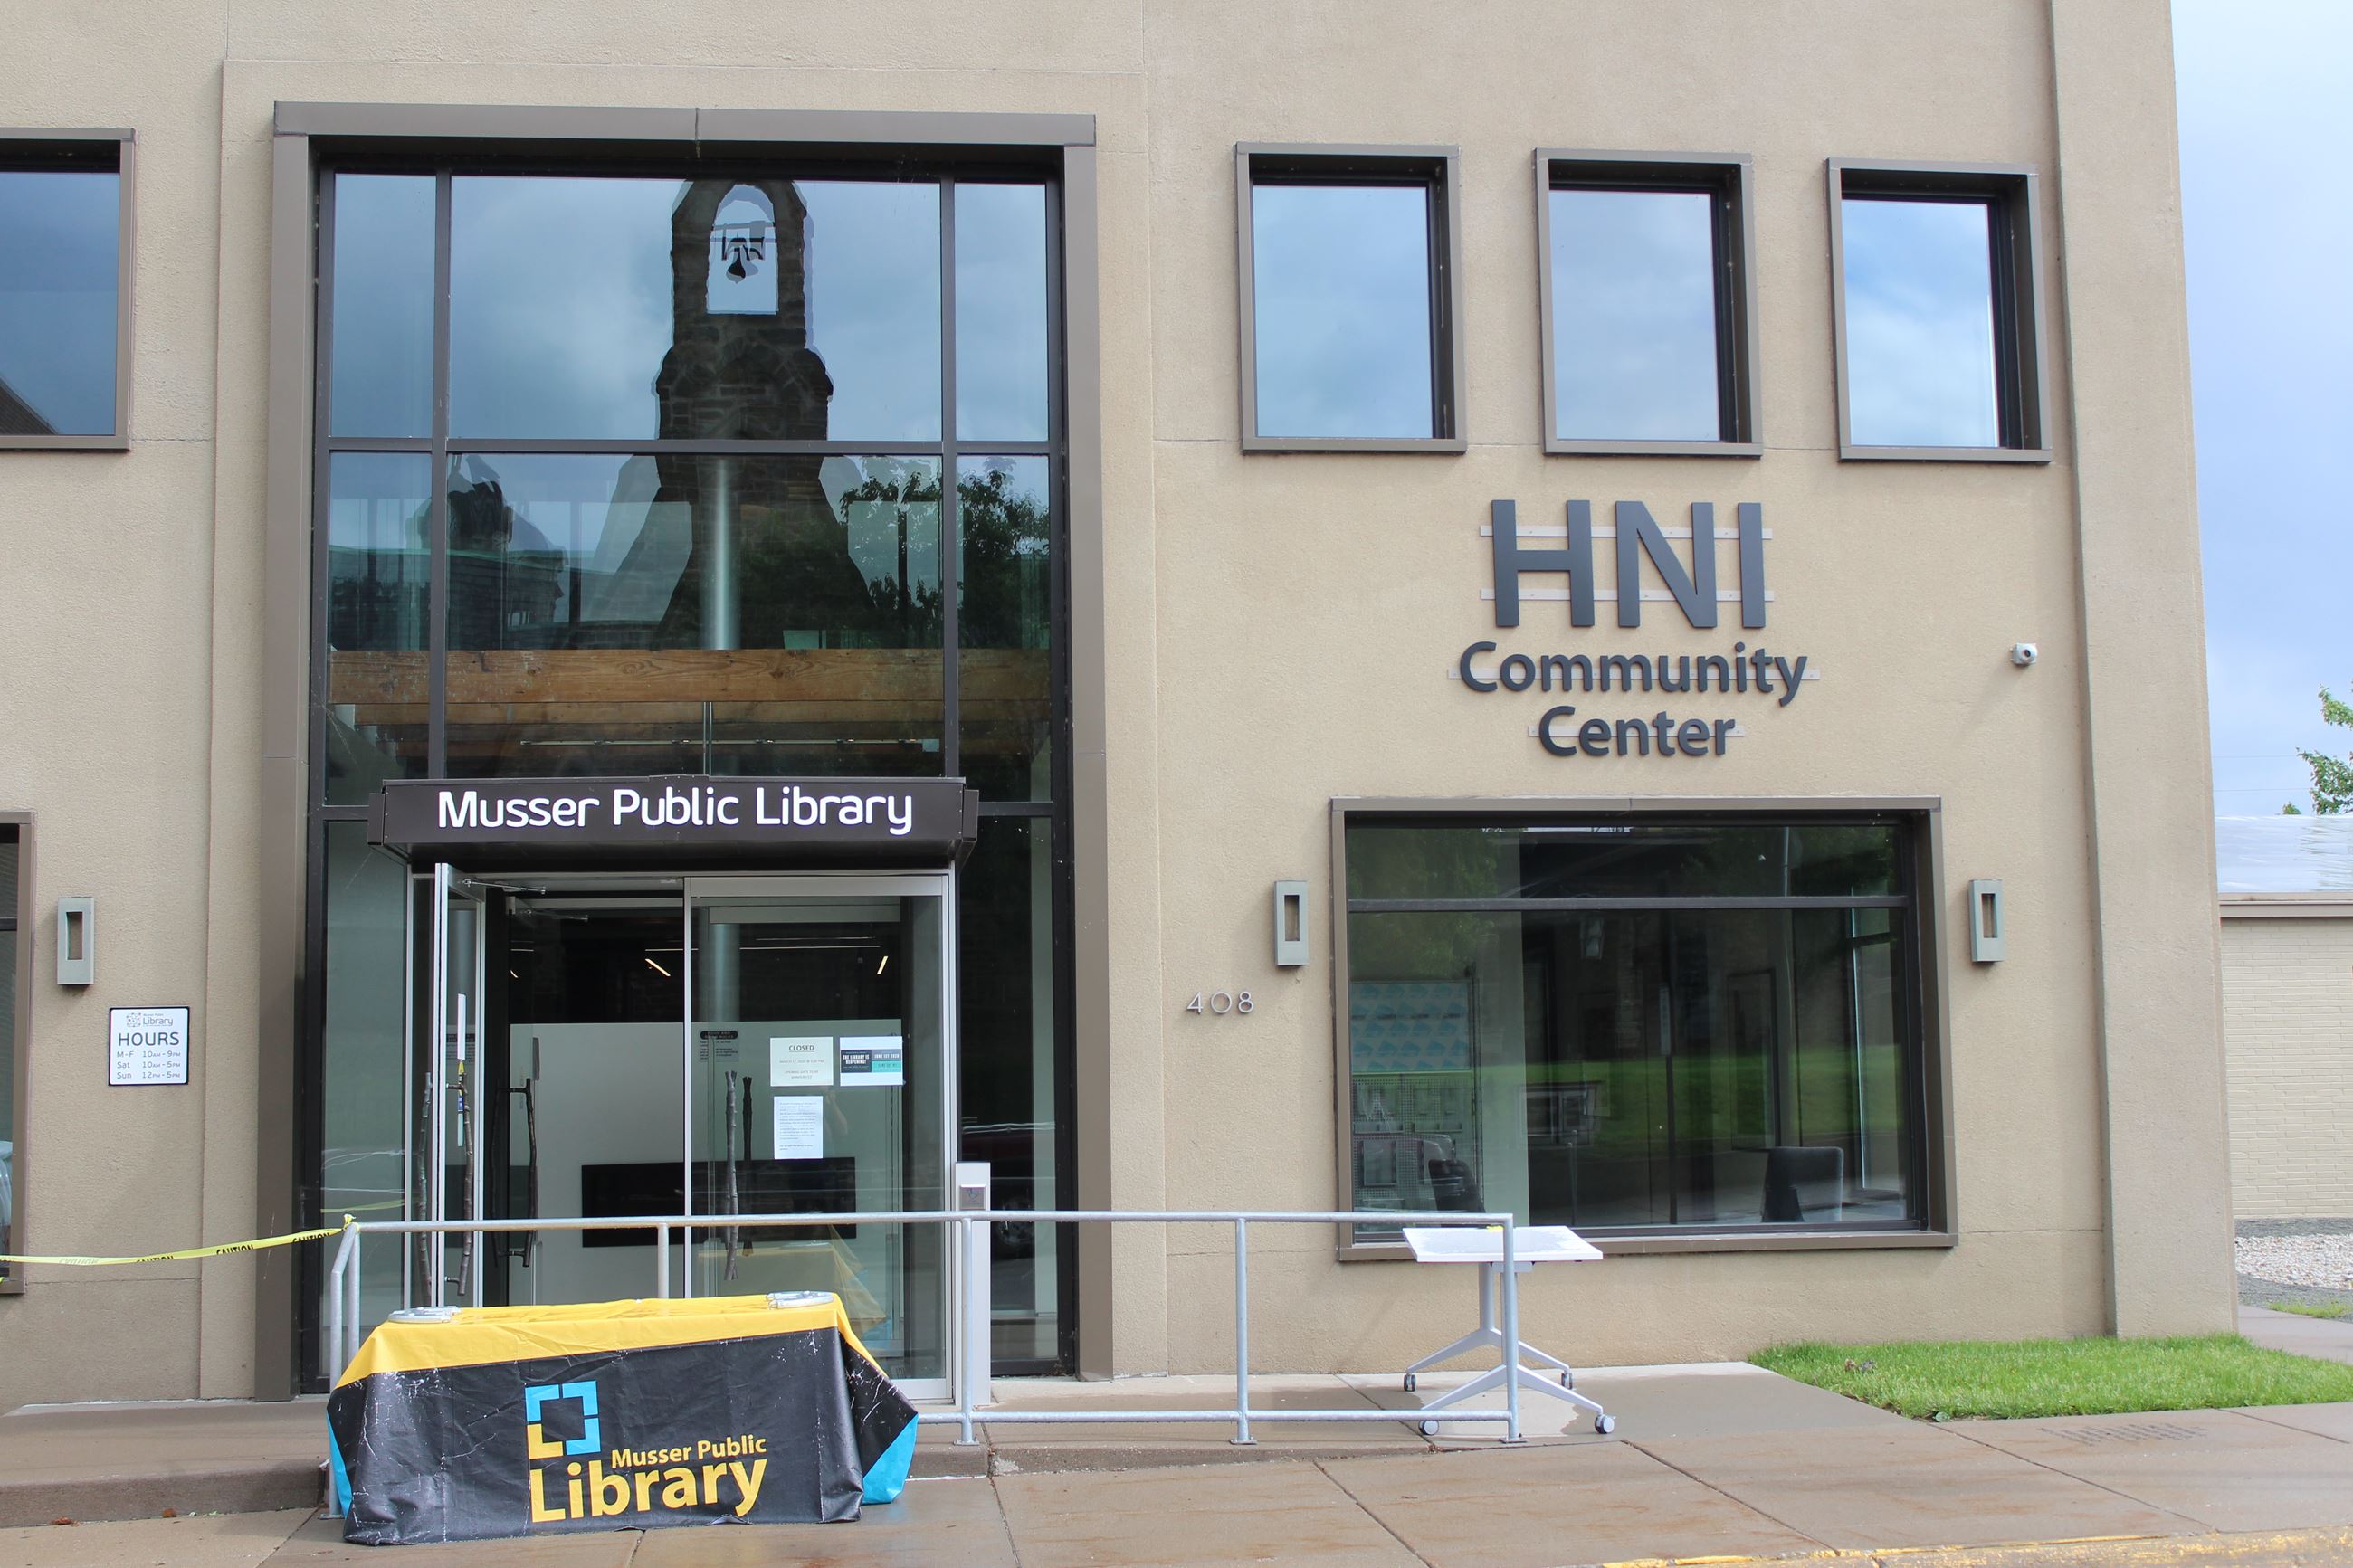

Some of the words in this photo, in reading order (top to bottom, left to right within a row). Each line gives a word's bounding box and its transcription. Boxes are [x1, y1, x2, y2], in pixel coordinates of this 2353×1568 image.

[1491, 499, 1766, 629] HNI
[1460, 641, 1808, 707] Community
[1538, 705, 1736, 757] Center
[438, 790, 600, 828] Musser
[613, 786, 739, 826] Public
[757, 785, 912, 836] Library
[143, 1017, 174, 1027] Library
[1186, 991, 1253, 1013] 408
[118, 1031, 180, 1047] HOURS
[117, 1071, 132, 1079] Sun
[611, 1446, 692, 1469] Musser
[697, 1434, 767, 1459] Public
[529, 1459, 768, 1523] Library
